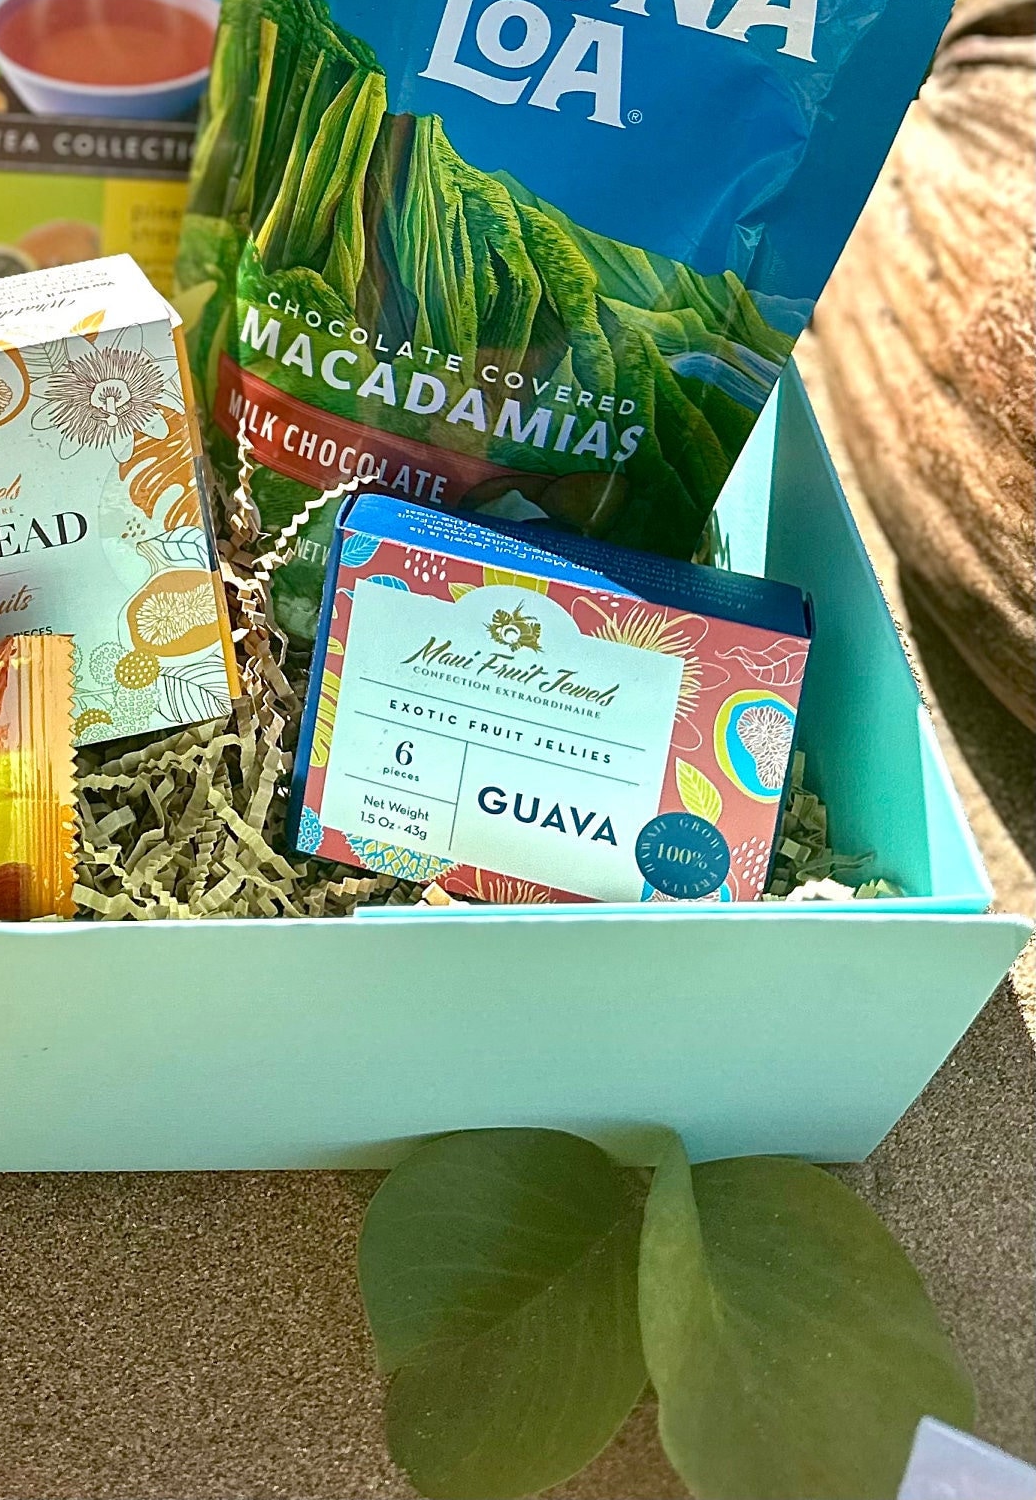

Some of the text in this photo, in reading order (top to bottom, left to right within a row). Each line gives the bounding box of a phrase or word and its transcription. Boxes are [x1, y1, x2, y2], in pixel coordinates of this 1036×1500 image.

[267, 291, 637, 417] CHOCOLATE COVERED
[238, 305, 646, 465] MACADAMIAS
[227, 387, 449, 506] MILK CHOCOLATE
[293, 536, 321, 564] NET
[401, 637, 621, 709] Maui Fruit Jewels
[412, 665, 603, 720] CONFECTION EXTRAORDINAIRE
[388, 699, 613, 765] EXOTIC FRUIT JELLIES
[394, 739, 415, 766] 6
[381, 765, 420, 784] pieces
[359, 810, 379, 826] 1.5
[380, 814, 396, 830] Oz
[363, 793, 430, 823] Net Weight
[477, 786, 620, 848] GUAVA
[657, 842, 708, 870] 100%
